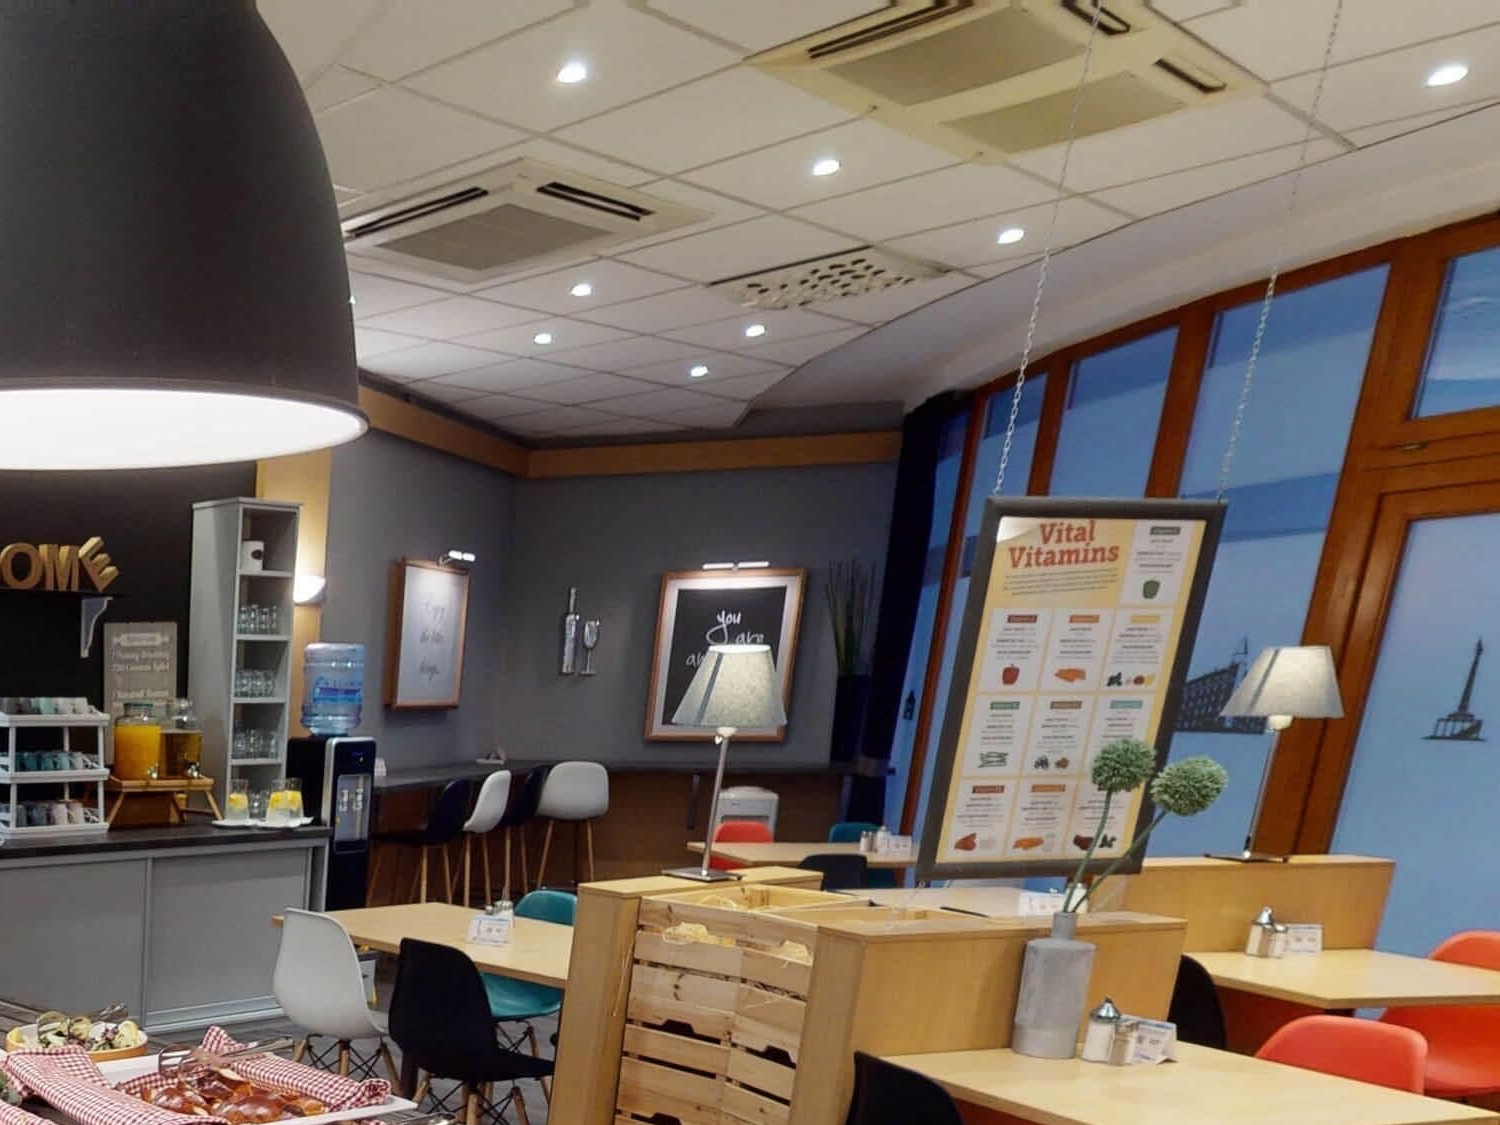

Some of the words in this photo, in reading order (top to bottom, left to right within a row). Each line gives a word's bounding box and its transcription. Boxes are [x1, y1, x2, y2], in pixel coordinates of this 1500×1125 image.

[1039, 520, 1096, 545] Vital
[1008, 542, 1120, 569] Vitamins
[706, 609, 742, 645] you
